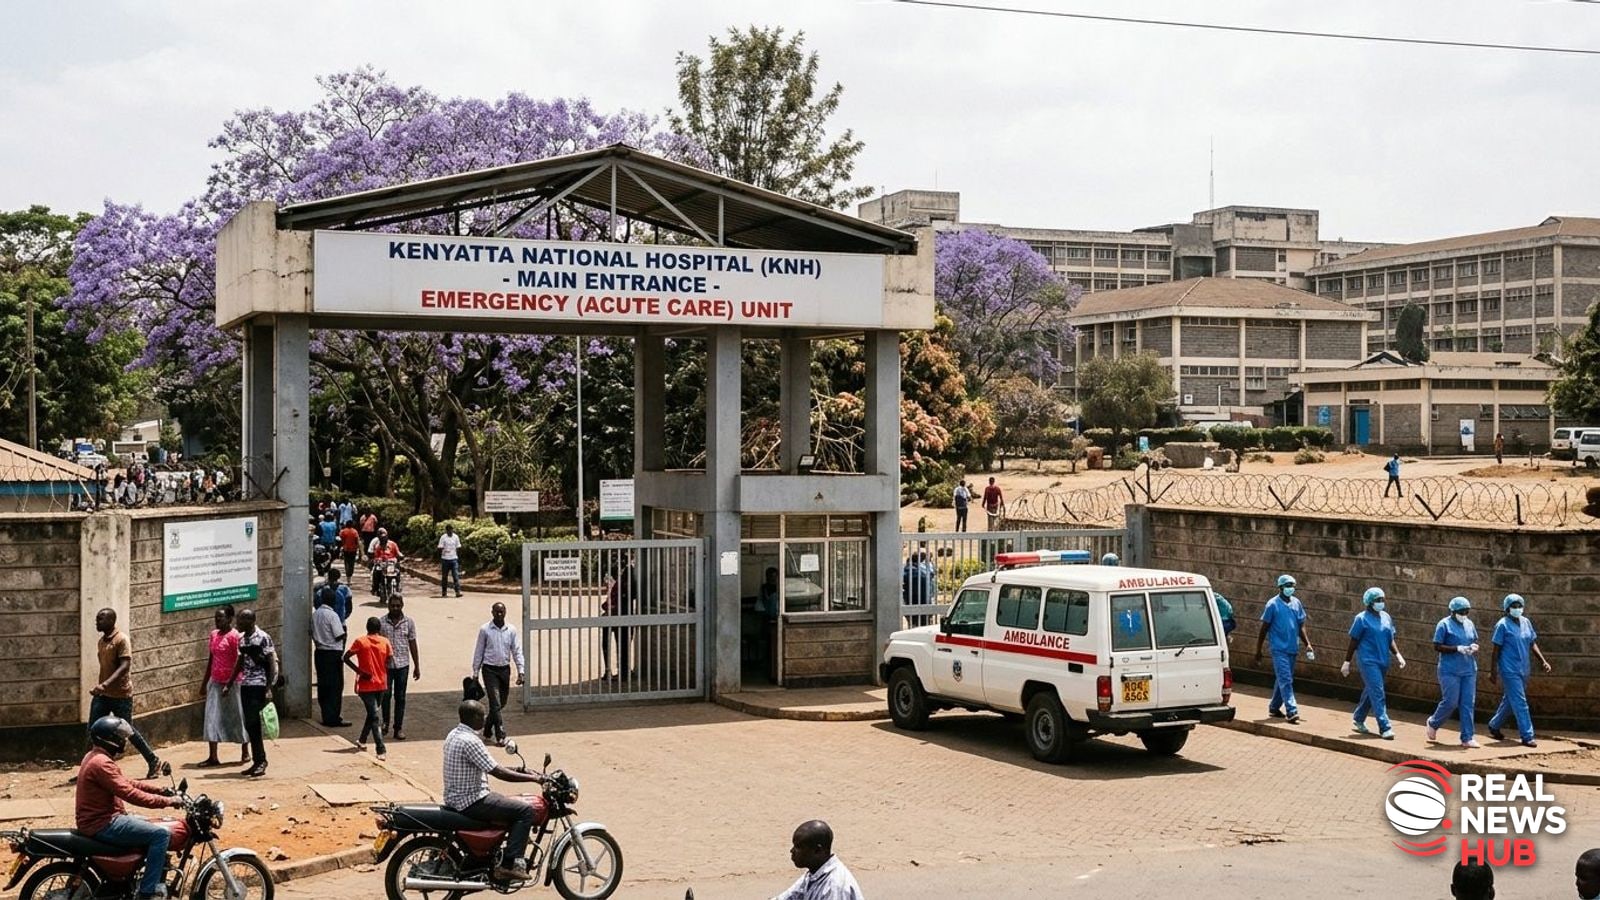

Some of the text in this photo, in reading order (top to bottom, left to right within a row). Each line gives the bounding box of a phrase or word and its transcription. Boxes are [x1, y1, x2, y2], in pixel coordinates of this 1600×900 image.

[389, 241, 821, 279] KENYATTA NATIONAL HOSPITAL (KNH)
[517, 270, 577, 289] MAIN
[585, 273, 707, 293] ENTRANCE
[421, 290, 793, 321] EMERGENCY (ACUTE CARE) UNIT
[1119, 576, 1195, 589] AMBULANCE
[1003, 629, 1070, 650] AMBULANCE
